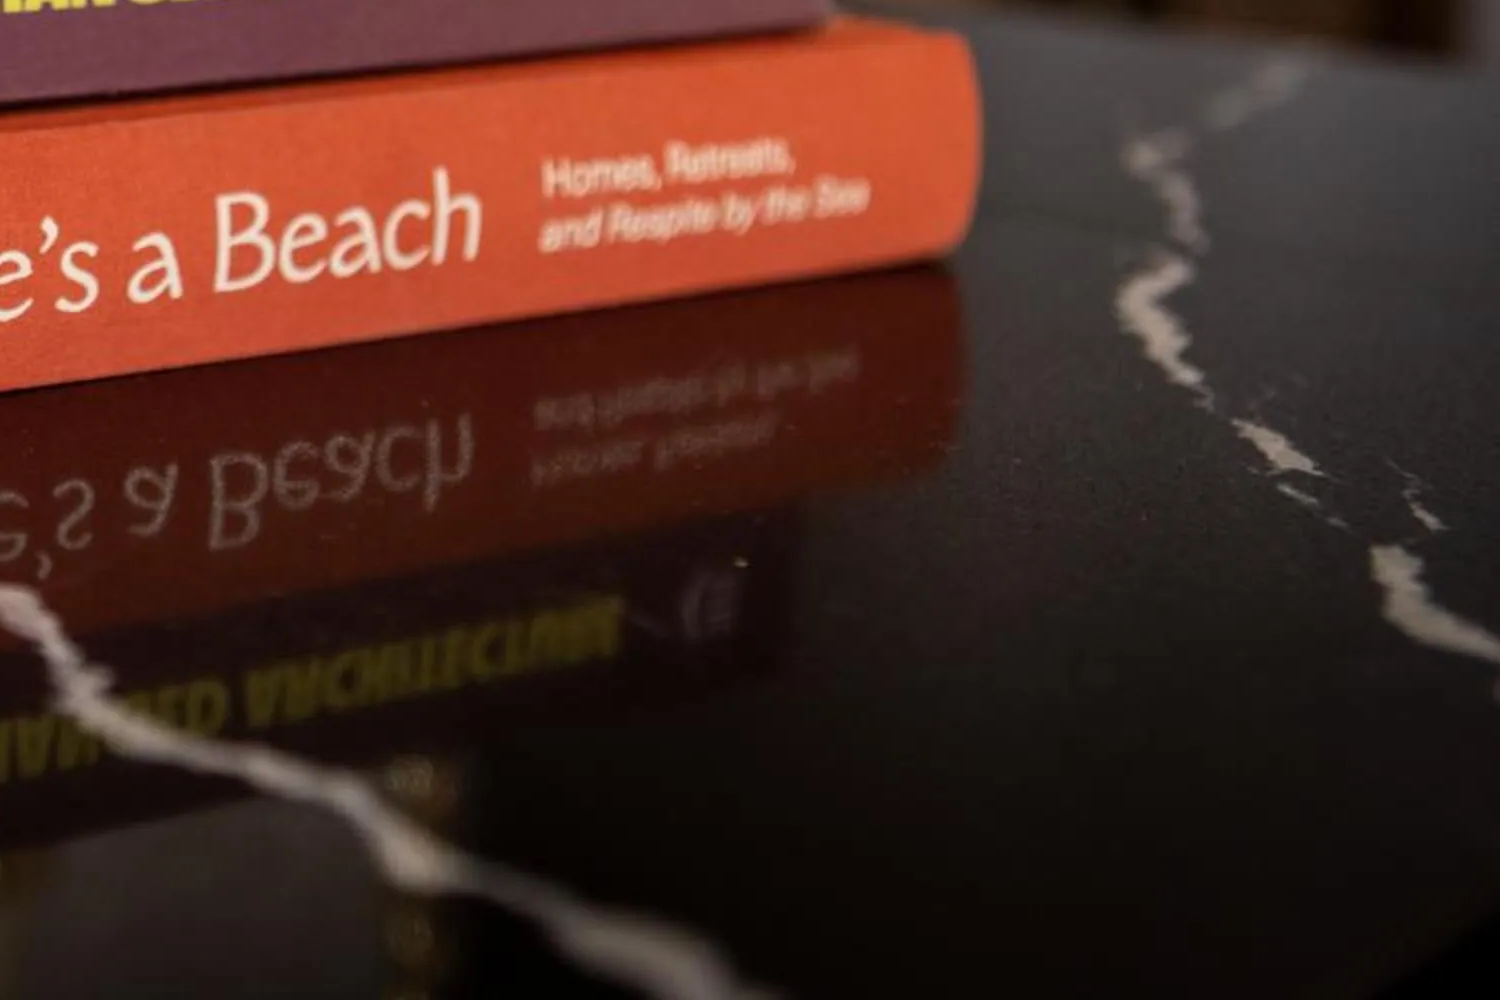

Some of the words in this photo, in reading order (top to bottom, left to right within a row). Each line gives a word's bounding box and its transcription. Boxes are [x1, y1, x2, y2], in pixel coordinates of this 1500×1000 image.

[542, 156, 662, 197] Homes,
[665, 138, 795, 182] Retreats,
[127, 231, 183, 304] a
[214, 166, 483, 293] Beach
[540, 209, 603, 253] and
[722, 193, 759, 235] by
[762, 186, 810, 223] the
[814, 176, 870, 216] Sea
